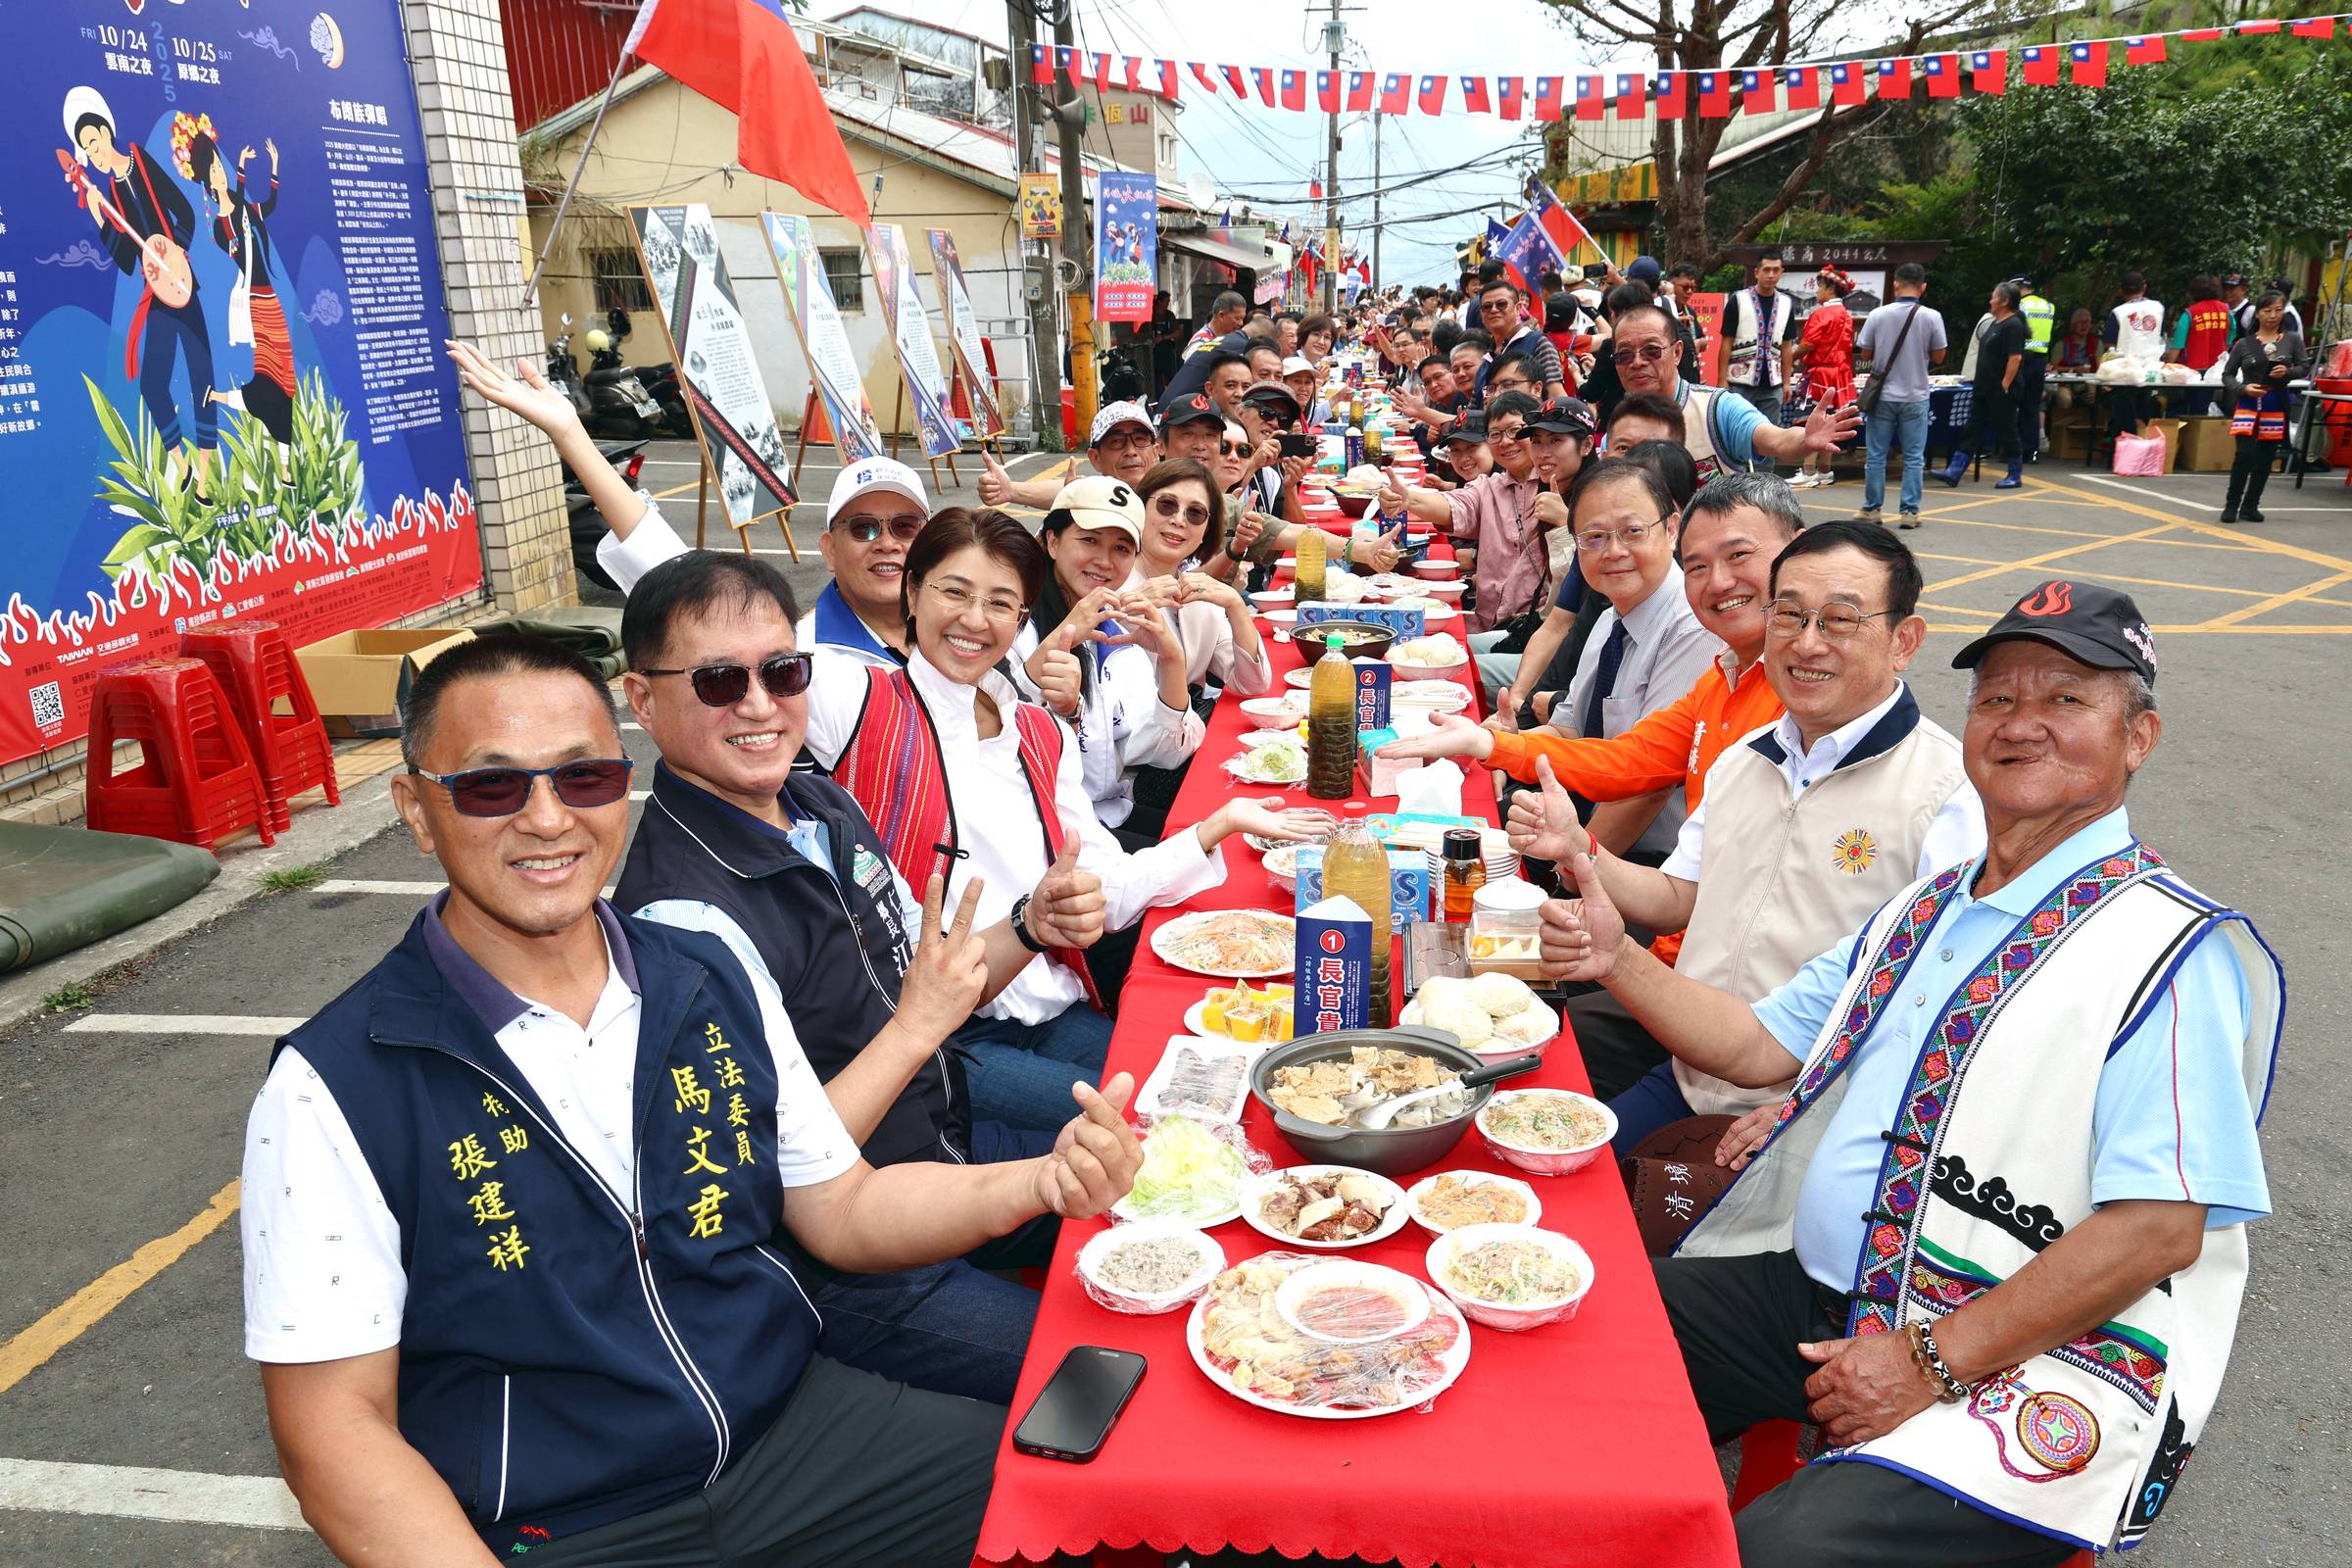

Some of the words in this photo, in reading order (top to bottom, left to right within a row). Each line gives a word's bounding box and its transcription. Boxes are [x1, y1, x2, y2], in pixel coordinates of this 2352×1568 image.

[80, 26, 96, 40] FRI
[105, 52, 153, 75] 雲南之夜
[218, 50, 232, 61] SAT
[177, 63, 220, 84] 原鄉之夜
[328, 99, 388, 125] 布朗族彈唱
[1823, 247, 1859, 261] 2044
[1108, 485, 1131, 508] S
[216, 514, 240, 527] 下午六點
[56, 646, 94, 663] TAIWAN
[1364, 672, 1372, 683] 2
[1328, 934, 1336, 950] 1
[705, 1021, 756, 1167] 立法委員
[482, 1091, 529, 1154] 特助
[670, 1065, 729, 1240] 馬文君
[447, 1132, 531, 1272] 張建祥
